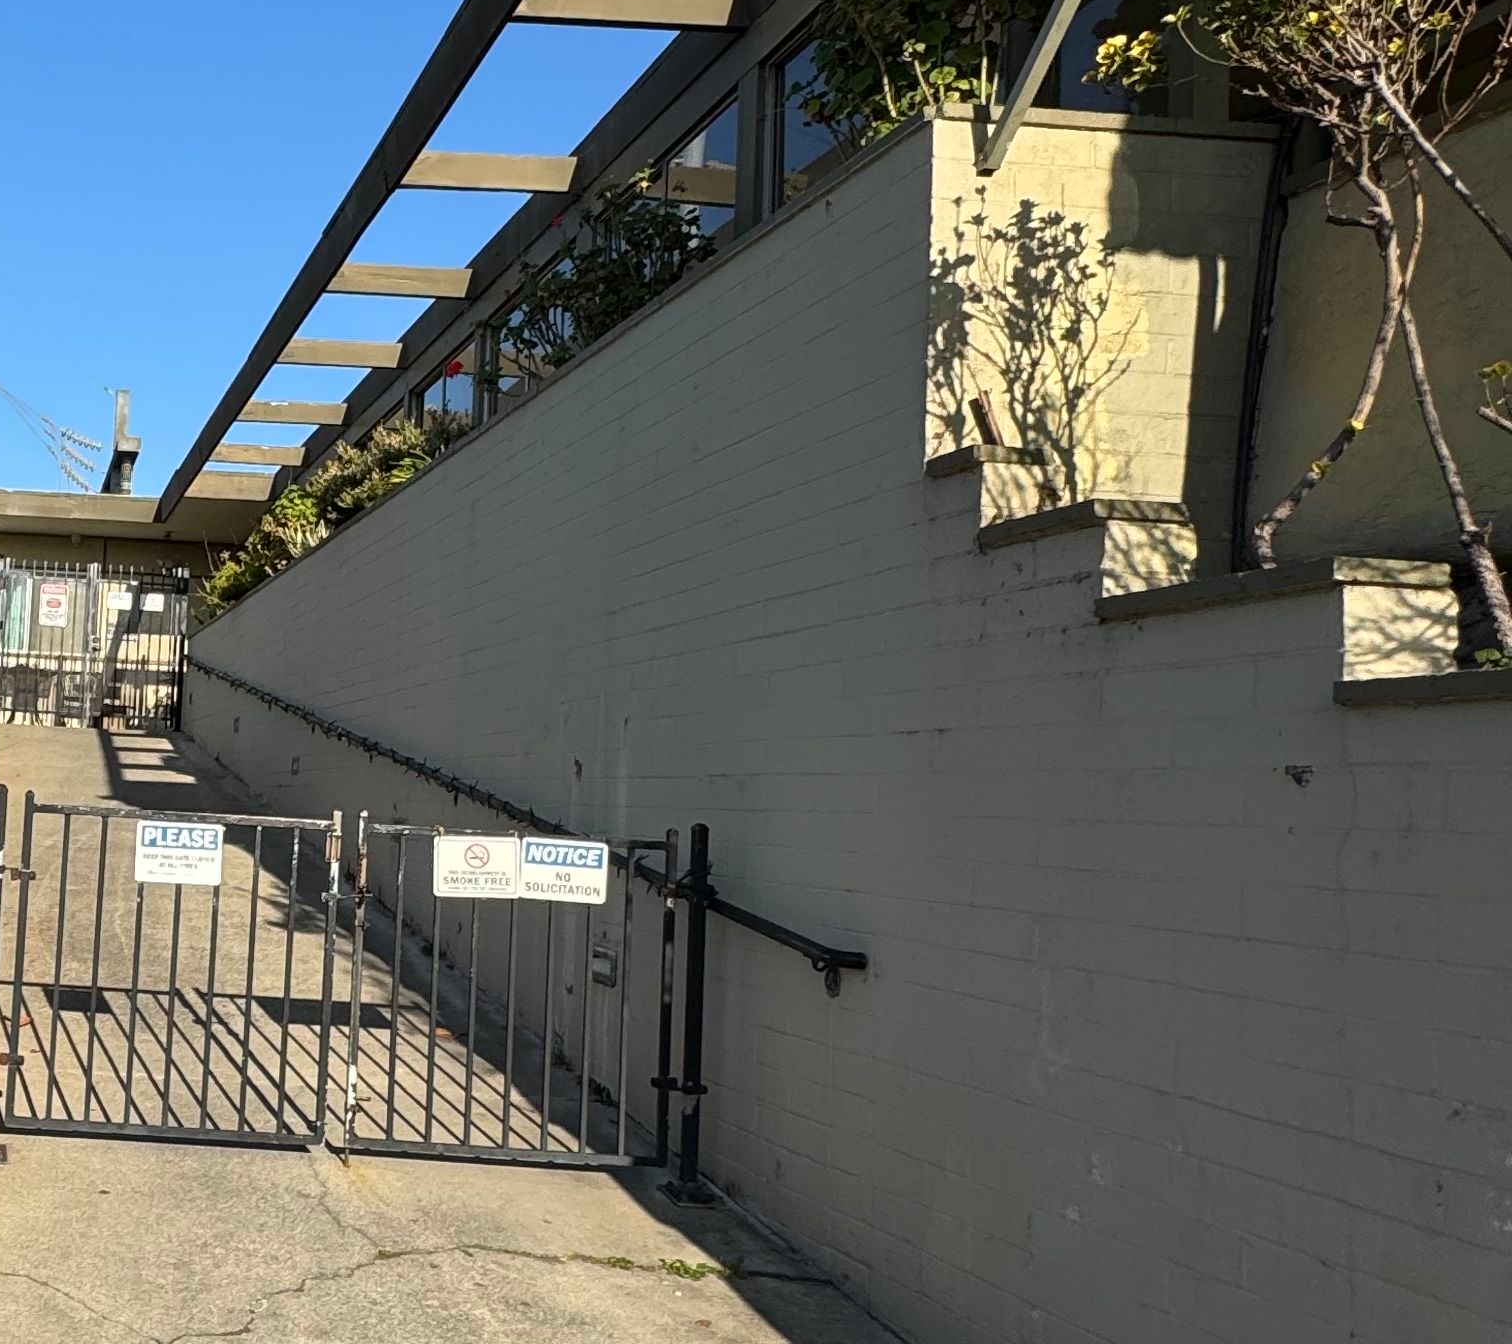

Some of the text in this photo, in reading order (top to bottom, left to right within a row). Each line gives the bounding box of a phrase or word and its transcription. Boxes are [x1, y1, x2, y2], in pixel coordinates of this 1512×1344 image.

[143, 827, 217, 848] PLEASE
[528, 844, 602, 866] NOTICE
[443, 876, 511, 886] SMOKE FREE
[555, 872, 571, 882] NO
[524, 881, 600, 896] SOLICITATION
